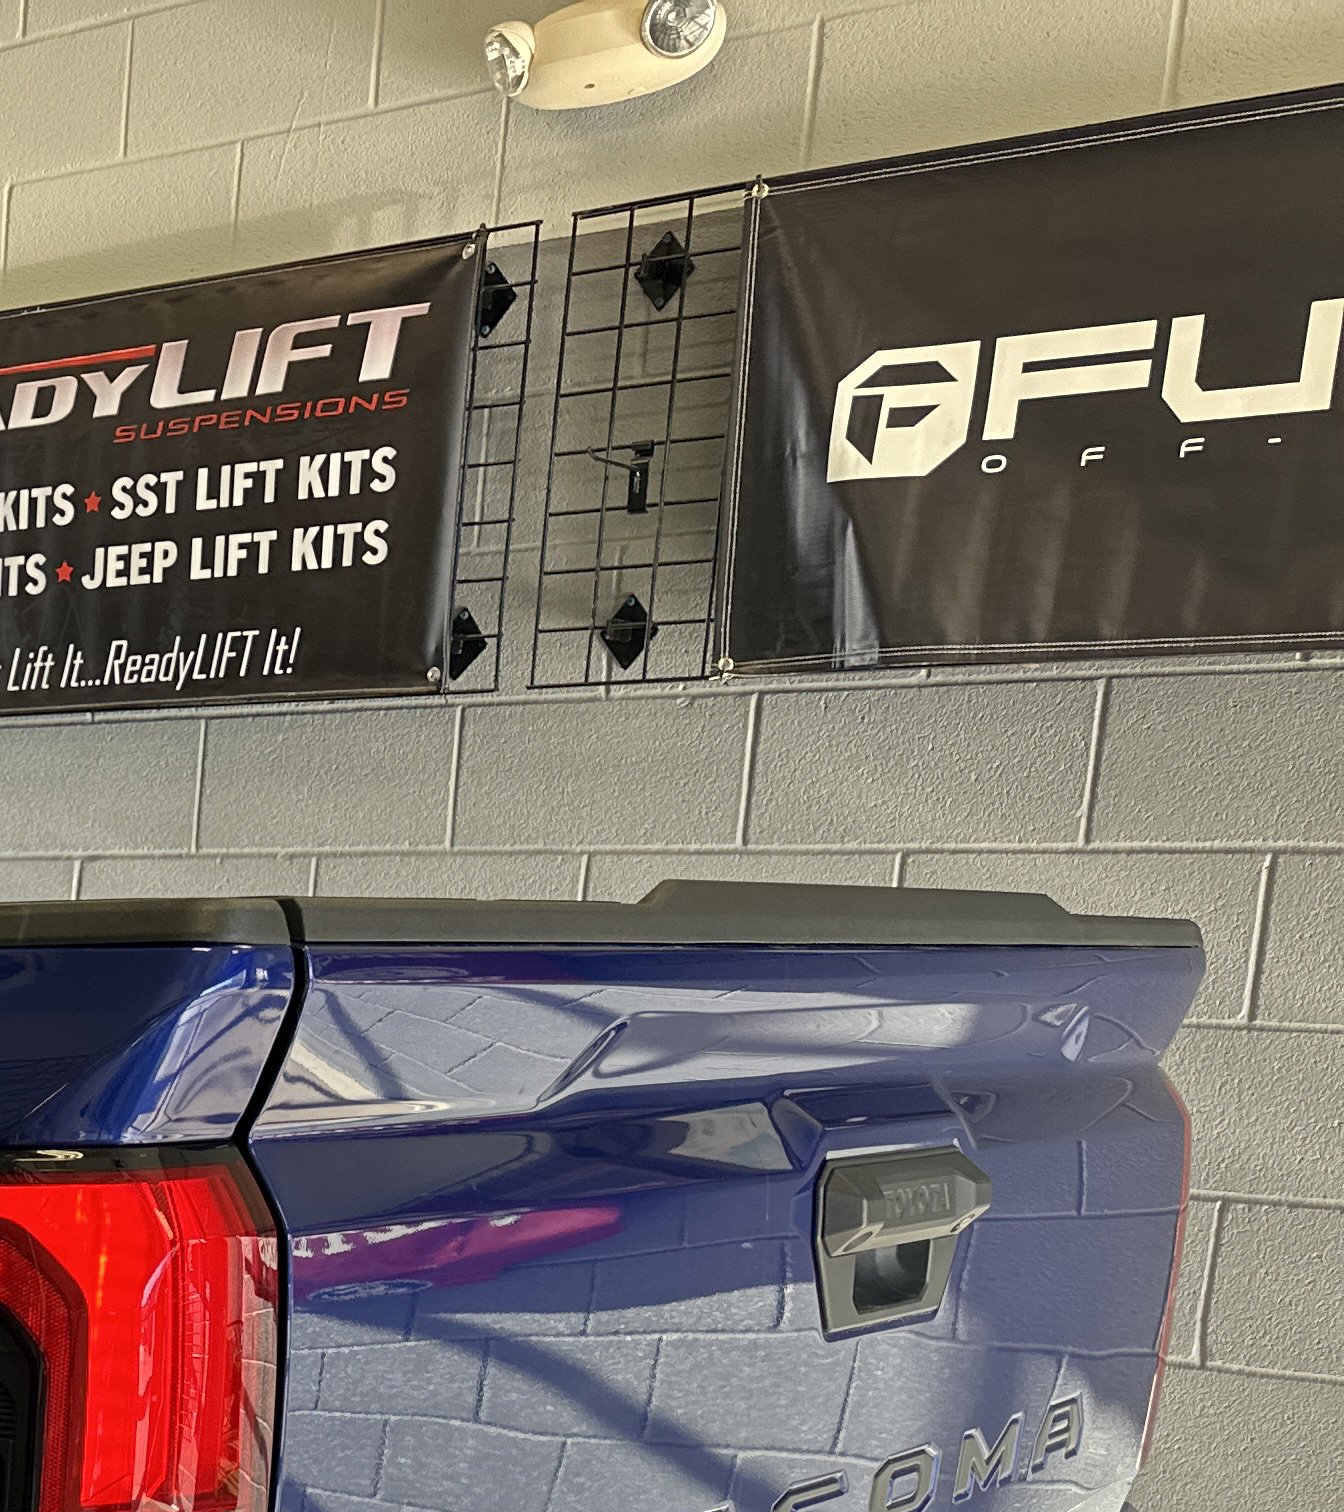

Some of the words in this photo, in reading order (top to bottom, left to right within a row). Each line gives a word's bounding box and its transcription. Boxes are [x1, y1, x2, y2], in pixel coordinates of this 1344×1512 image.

[112, 388, 410, 444] SUSPENSIONS
[110, 470, 185, 521] SST
[195, 458, 285, 511] LIFT
[297, 445, 398, 501] KITS
[80, 540, 179, 591] JEEP
[189, 530, 279, 581] LIFT
[290, 519, 390, 573] KITS
[6, 644, 56, 692] Lift
[261, 626, 302, 676] It!
